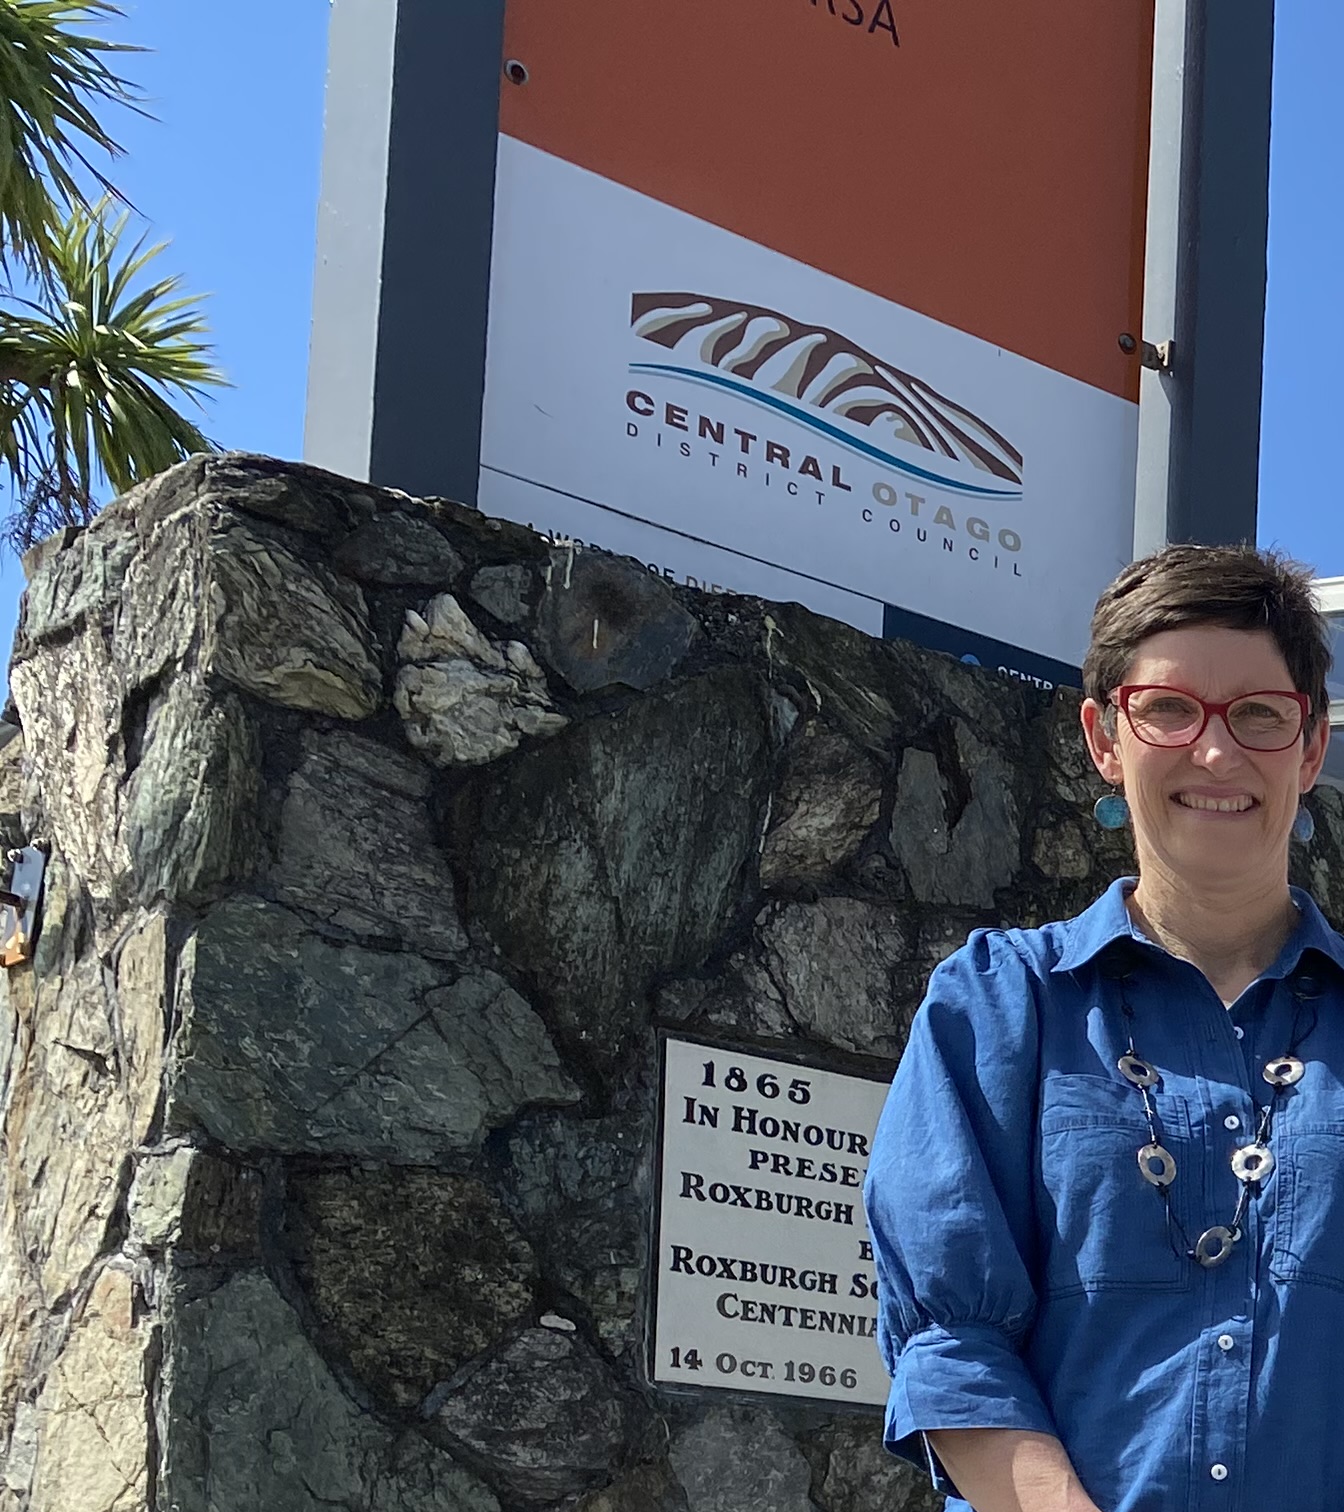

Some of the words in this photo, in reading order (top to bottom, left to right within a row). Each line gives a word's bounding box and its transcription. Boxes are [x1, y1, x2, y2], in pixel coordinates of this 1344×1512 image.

[809, 0, 899, 47] SA
[626, 390, 852, 492] CENTRAL
[872, 482, 1022, 552] OTAGO
[627, 422, 825, 505] DISTRICT
[862, 509, 1022, 577] COUNCIL
[702, 1060, 811, 1104] 1865
[749, 1149, 868, 1187] PRESE
[679, 1172, 854, 1225] ROXBURGH
[670, 1245, 838, 1295] ROXBURGH
[670, 1347, 703, 1370] 14
[784, 1360, 858, 1389] 1966
